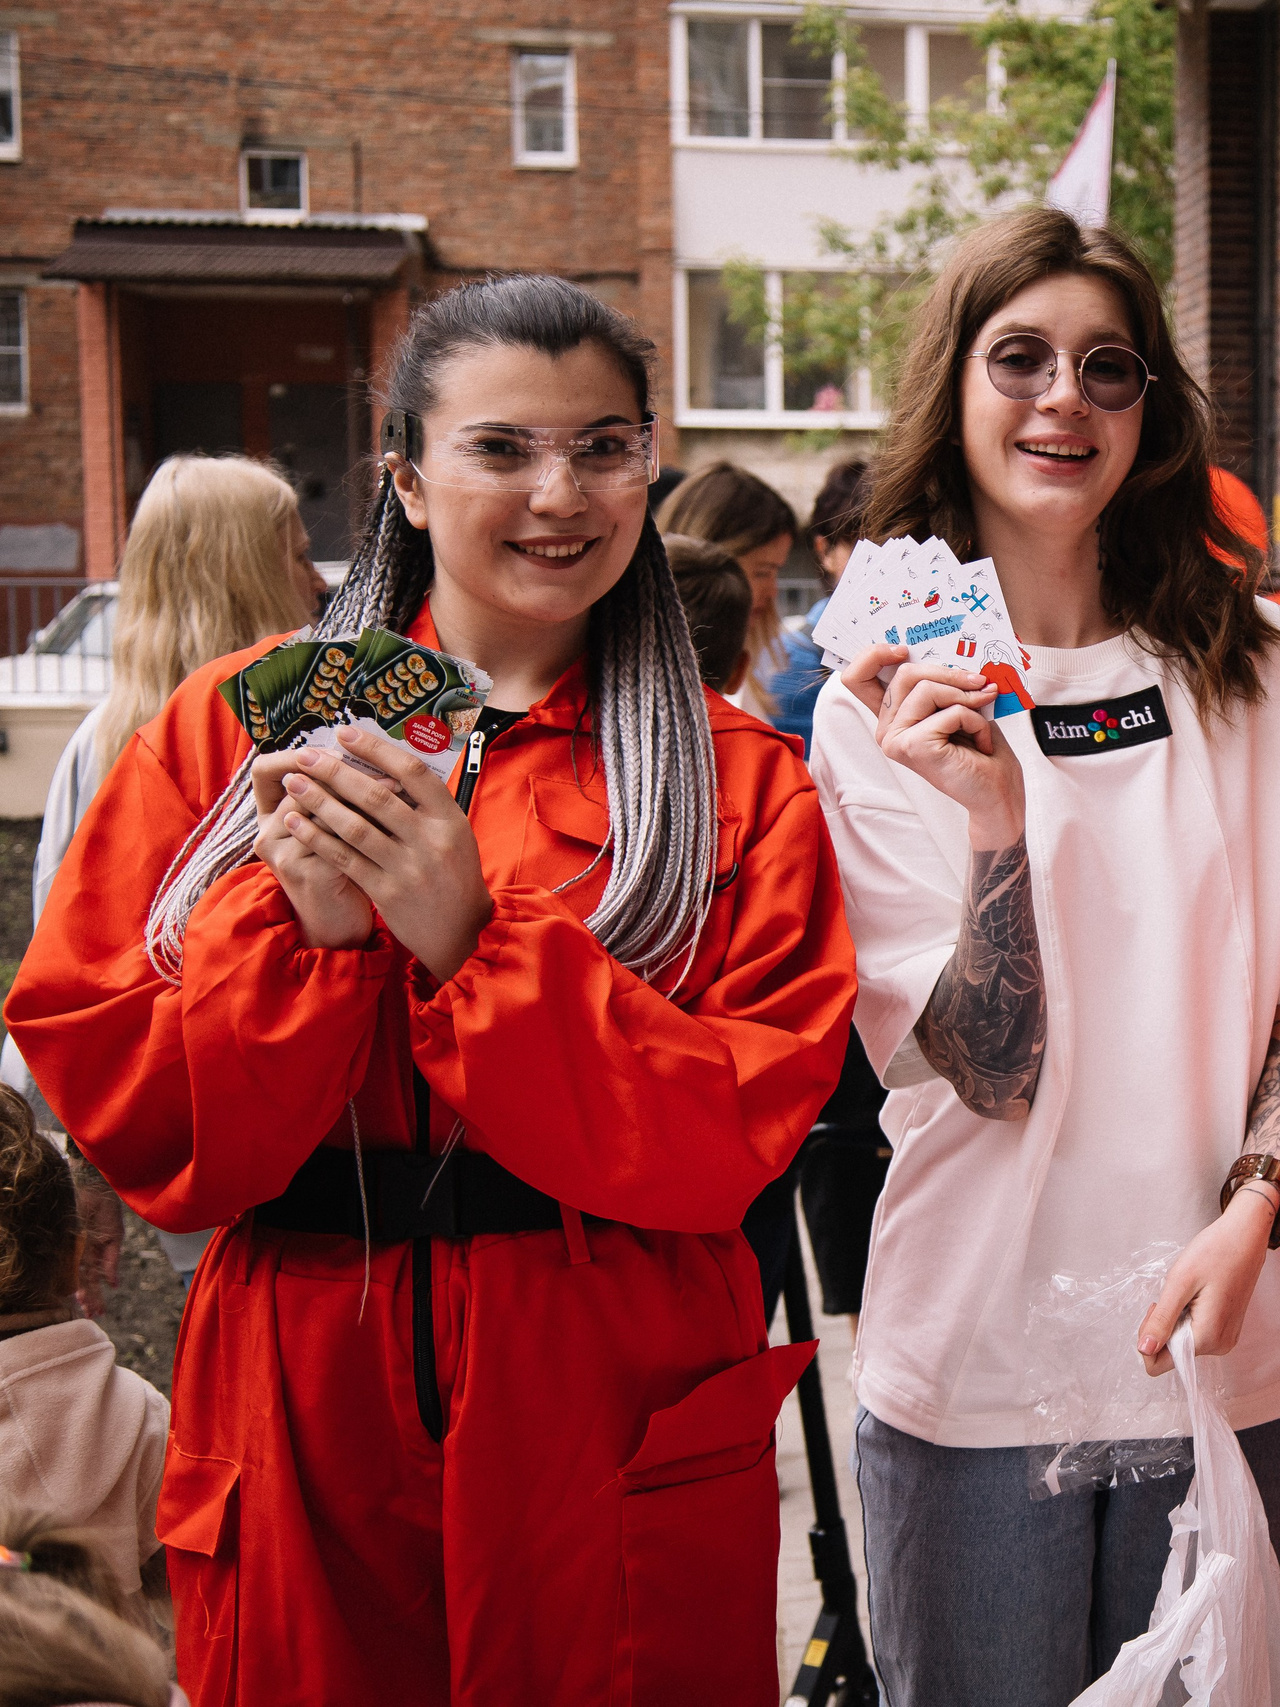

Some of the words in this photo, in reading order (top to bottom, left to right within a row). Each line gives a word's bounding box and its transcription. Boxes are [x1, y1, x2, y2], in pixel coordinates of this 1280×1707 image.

[868, 600, 889, 616] kimchi
[898, 597, 920, 609] kimchi
[906, 615, 953, 636] ПОДАРОК
[909, 632, 930, 646] ДЛЯ
[932, 623, 960, 639] ТЕБЯ!
[455, 688, 480, 705] kimchi
[412, 722, 431, 734] ДАРИМ
[414, 736, 439, 751] КУРИЦЕЙ
